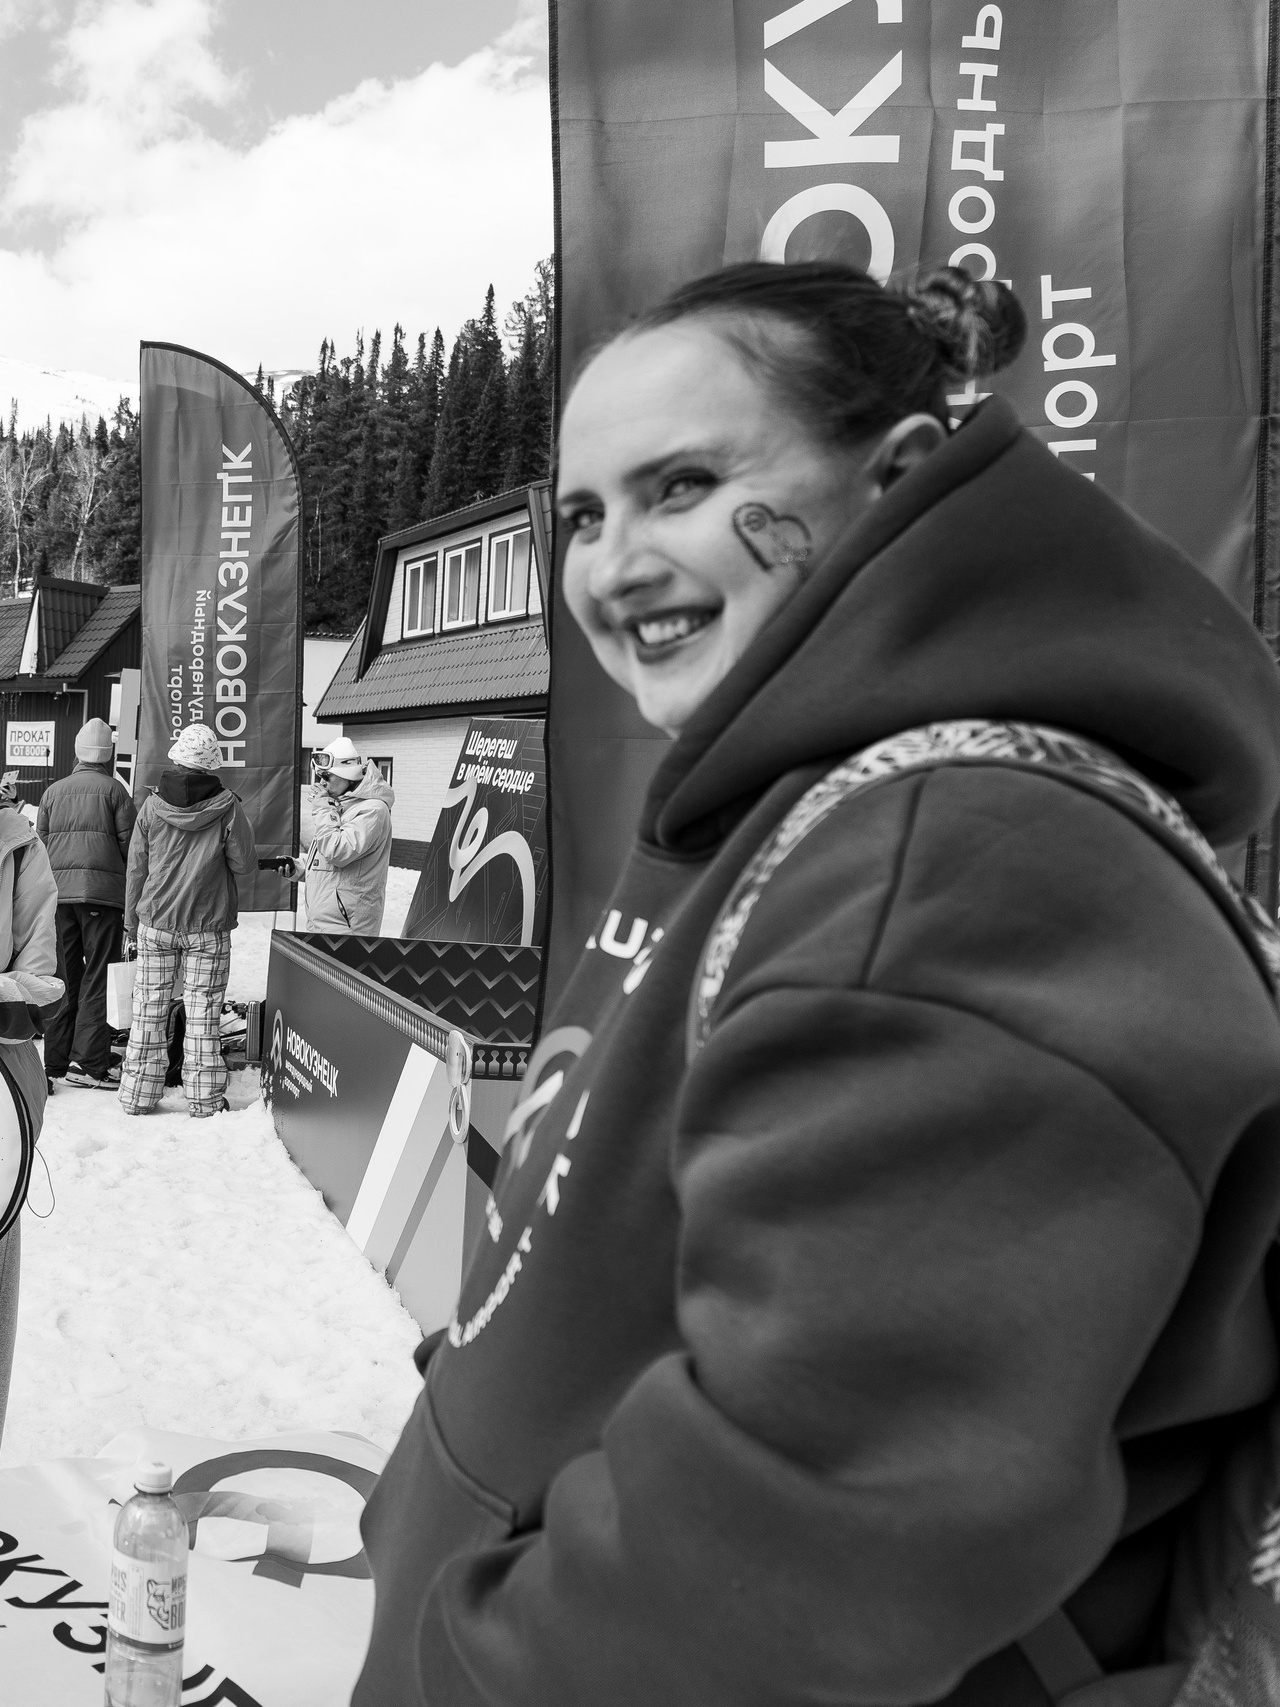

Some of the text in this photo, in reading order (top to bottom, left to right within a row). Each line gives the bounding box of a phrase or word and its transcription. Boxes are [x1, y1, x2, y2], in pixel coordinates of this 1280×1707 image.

[10, 730, 51, 743] ПРОКАТ
[465, 730, 518, 762] Шерегеш
[456, 760, 535, 795] в моём сердце
[286, 1026, 339, 1098] НОВОКУЗНЕЦК
